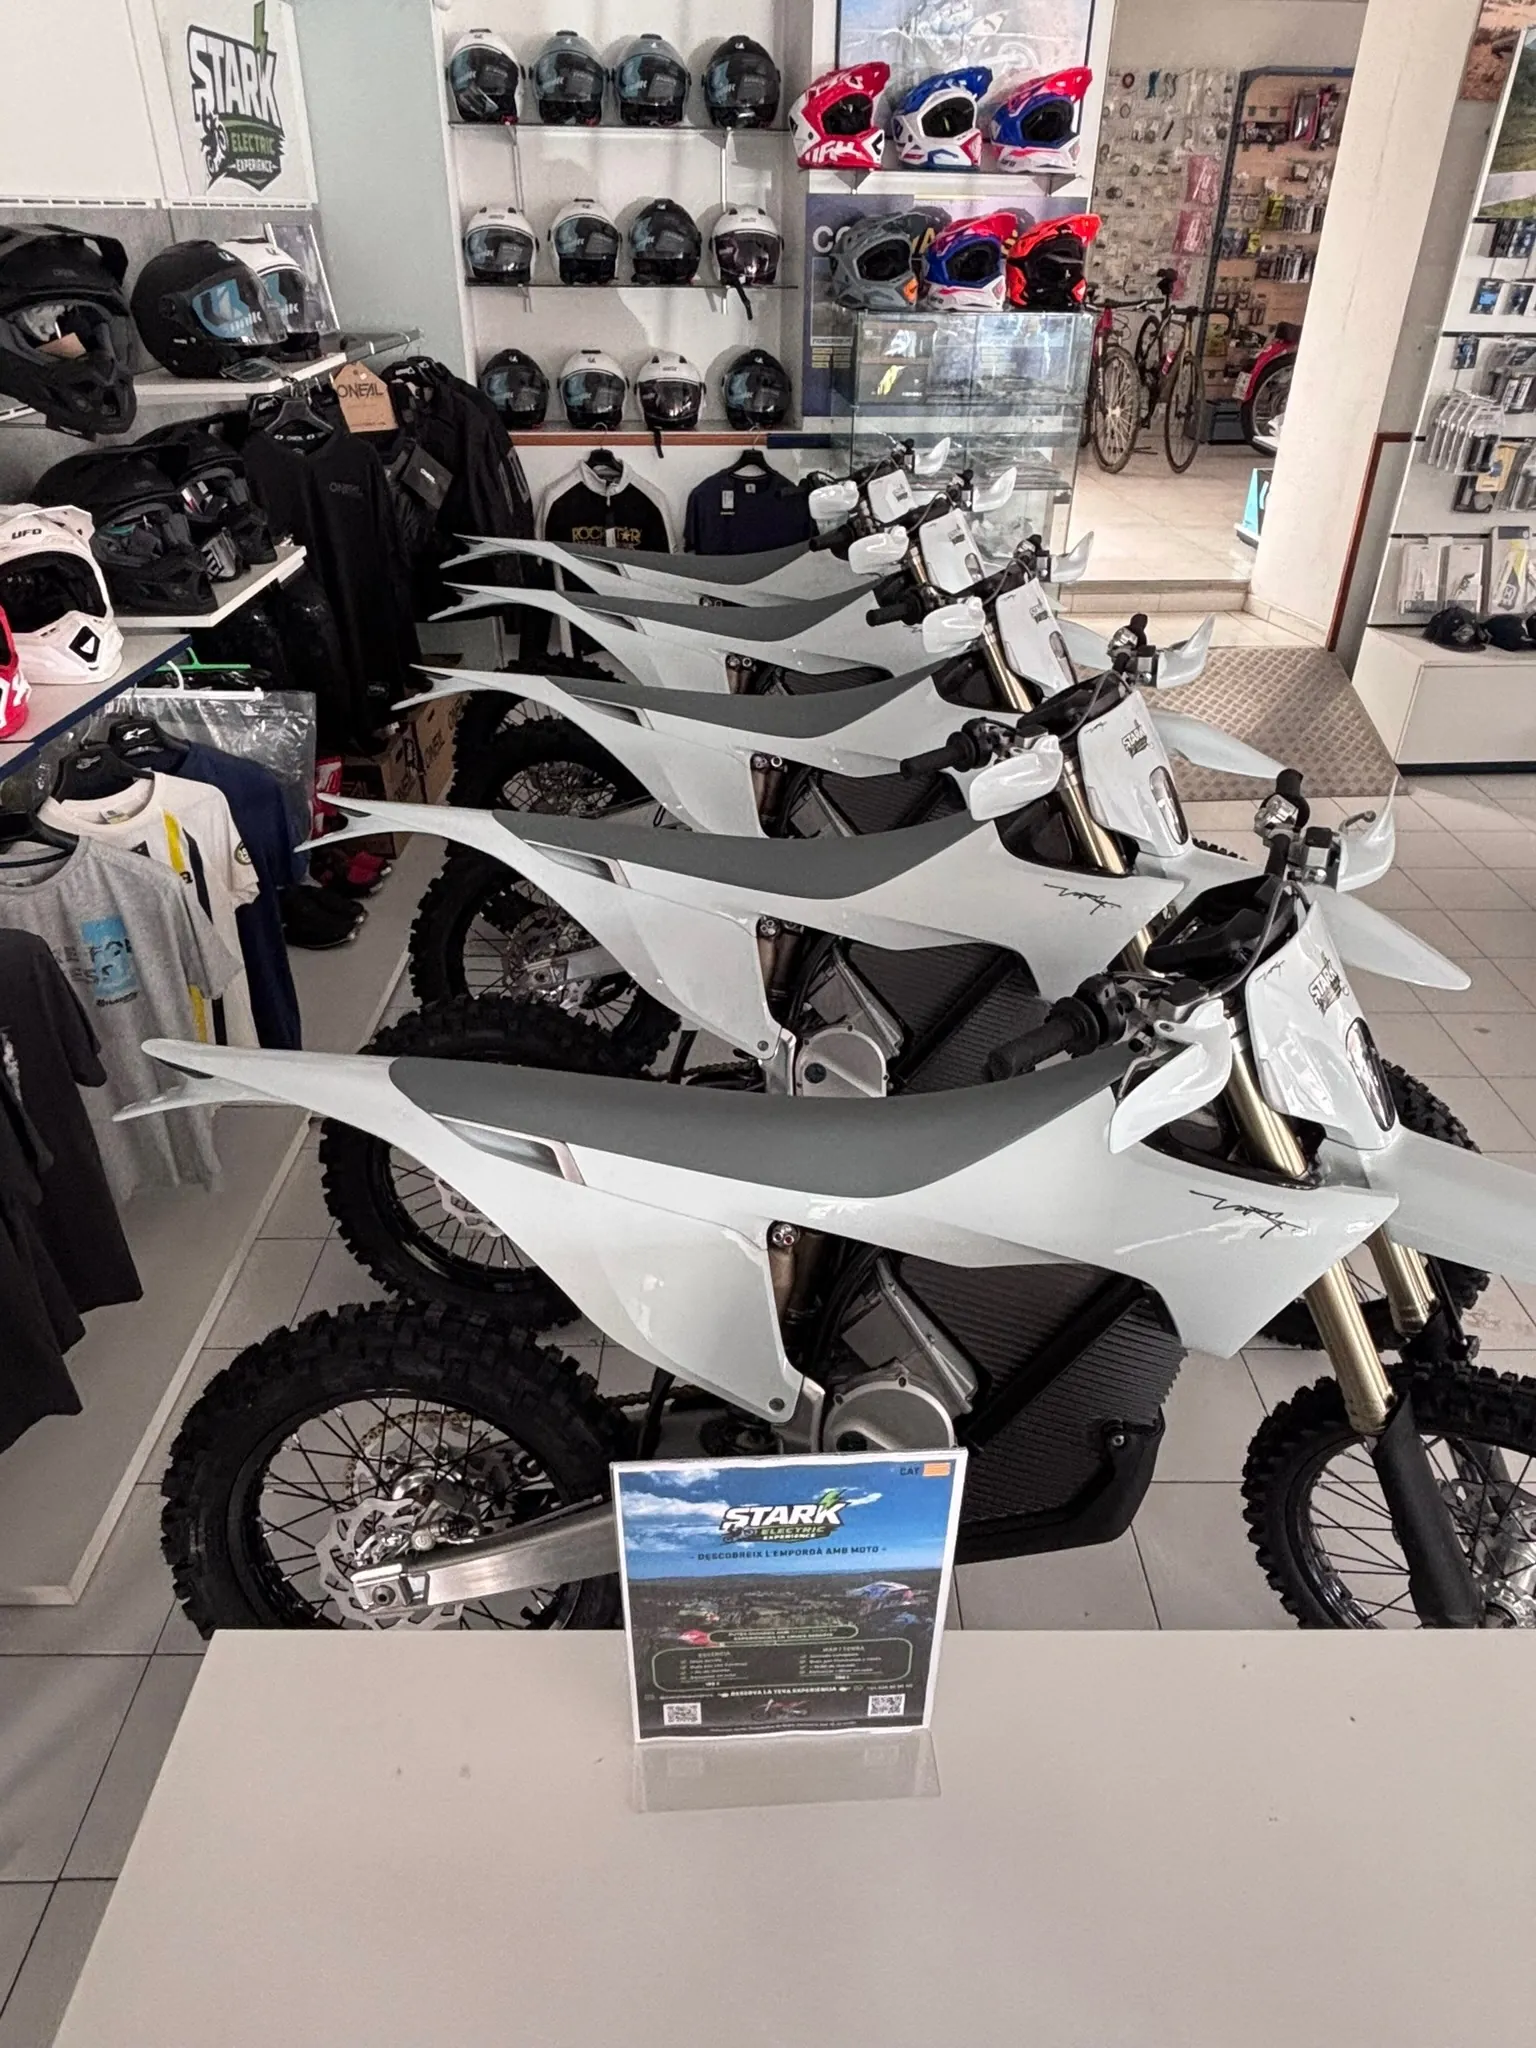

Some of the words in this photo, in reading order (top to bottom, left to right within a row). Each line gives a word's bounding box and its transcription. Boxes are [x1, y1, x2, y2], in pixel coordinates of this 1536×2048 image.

[187, 30, 282, 130] STARK
[230, 132, 276, 155] ELECTRIC
[235, 158, 273, 173] EXPERIENCE
[337, 383, 384, 398] ONEAL
[11, 527, 42, 540] UFO
[900, 1467, 919, 1476] CAT
[723, 1502, 844, 1531] STARK
[760, 1525, 826, 1536] ELECTRIC
[762, 1533, 816, 1541] EXPERIENCE
[697, 1550, 763, 1561] DESCOBREIX
[825, 1546, 849, 1555] AMB
[851, 1545, 879, 1554] MOTO
